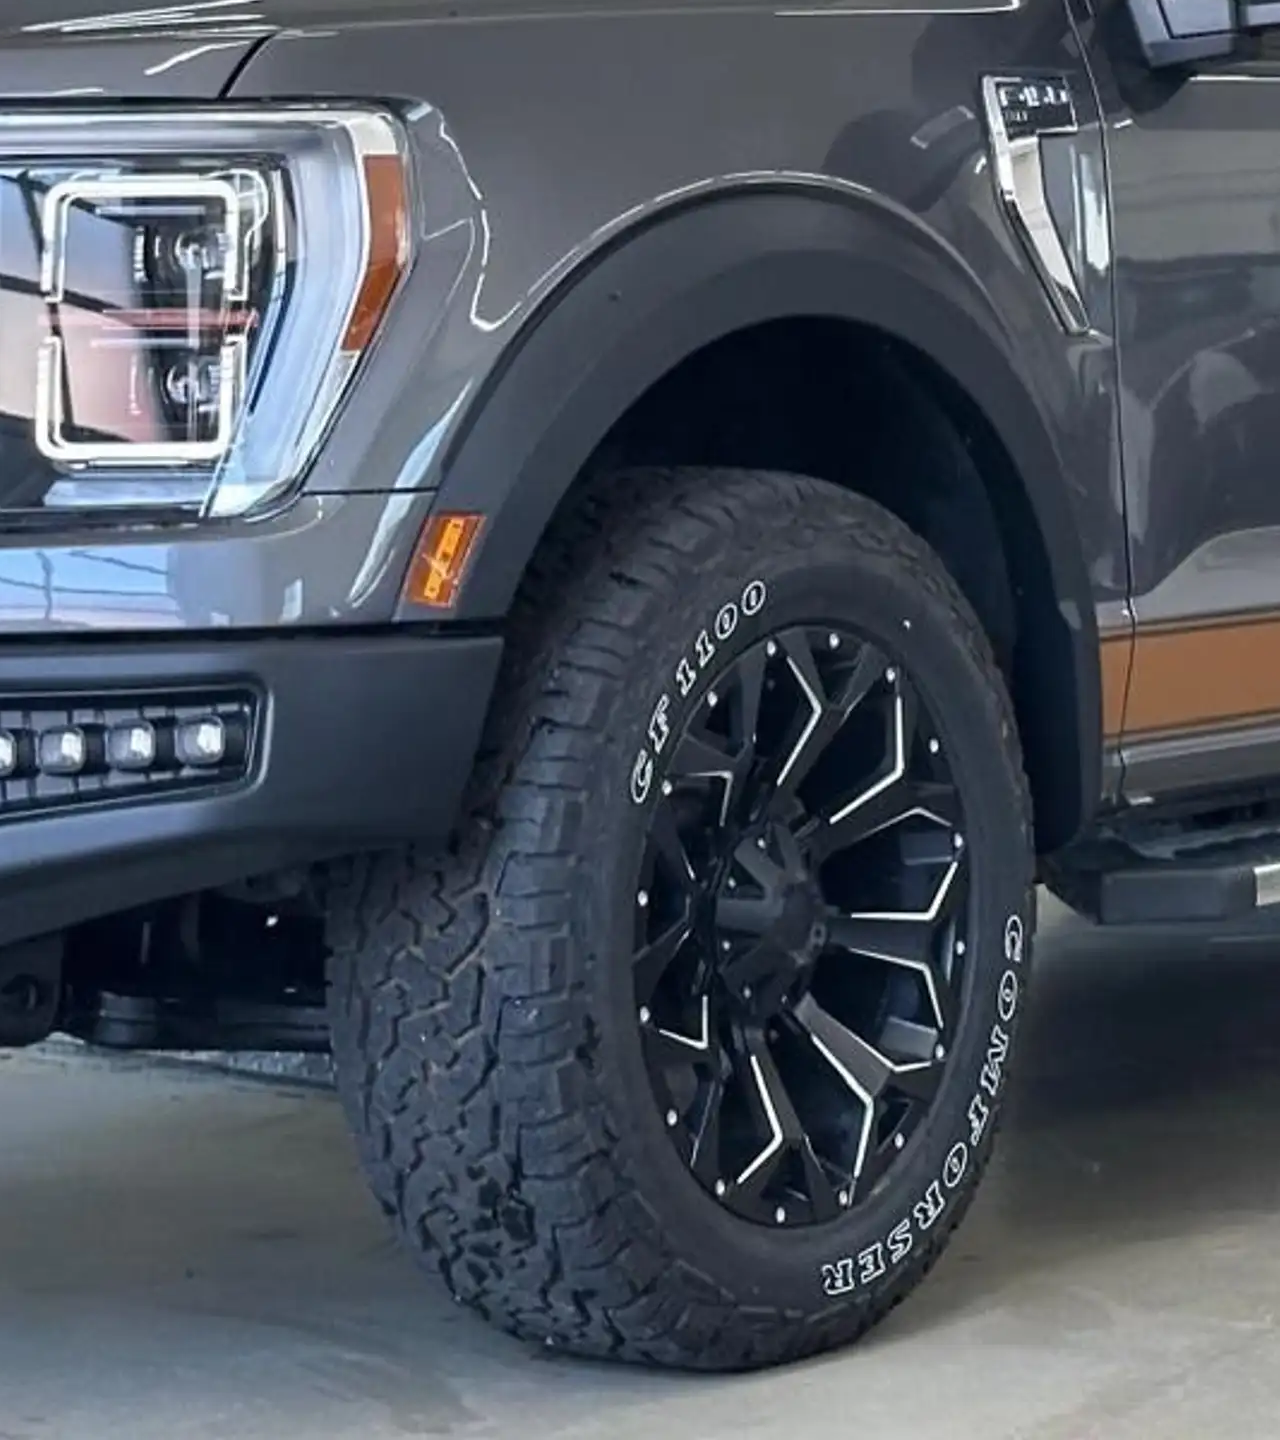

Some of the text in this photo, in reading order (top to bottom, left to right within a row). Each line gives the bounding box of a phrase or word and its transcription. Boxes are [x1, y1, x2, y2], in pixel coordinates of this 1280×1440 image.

[630, 579, 767, 804] CF 1100
[821, 913, 1024, 1296] COMFORSER
